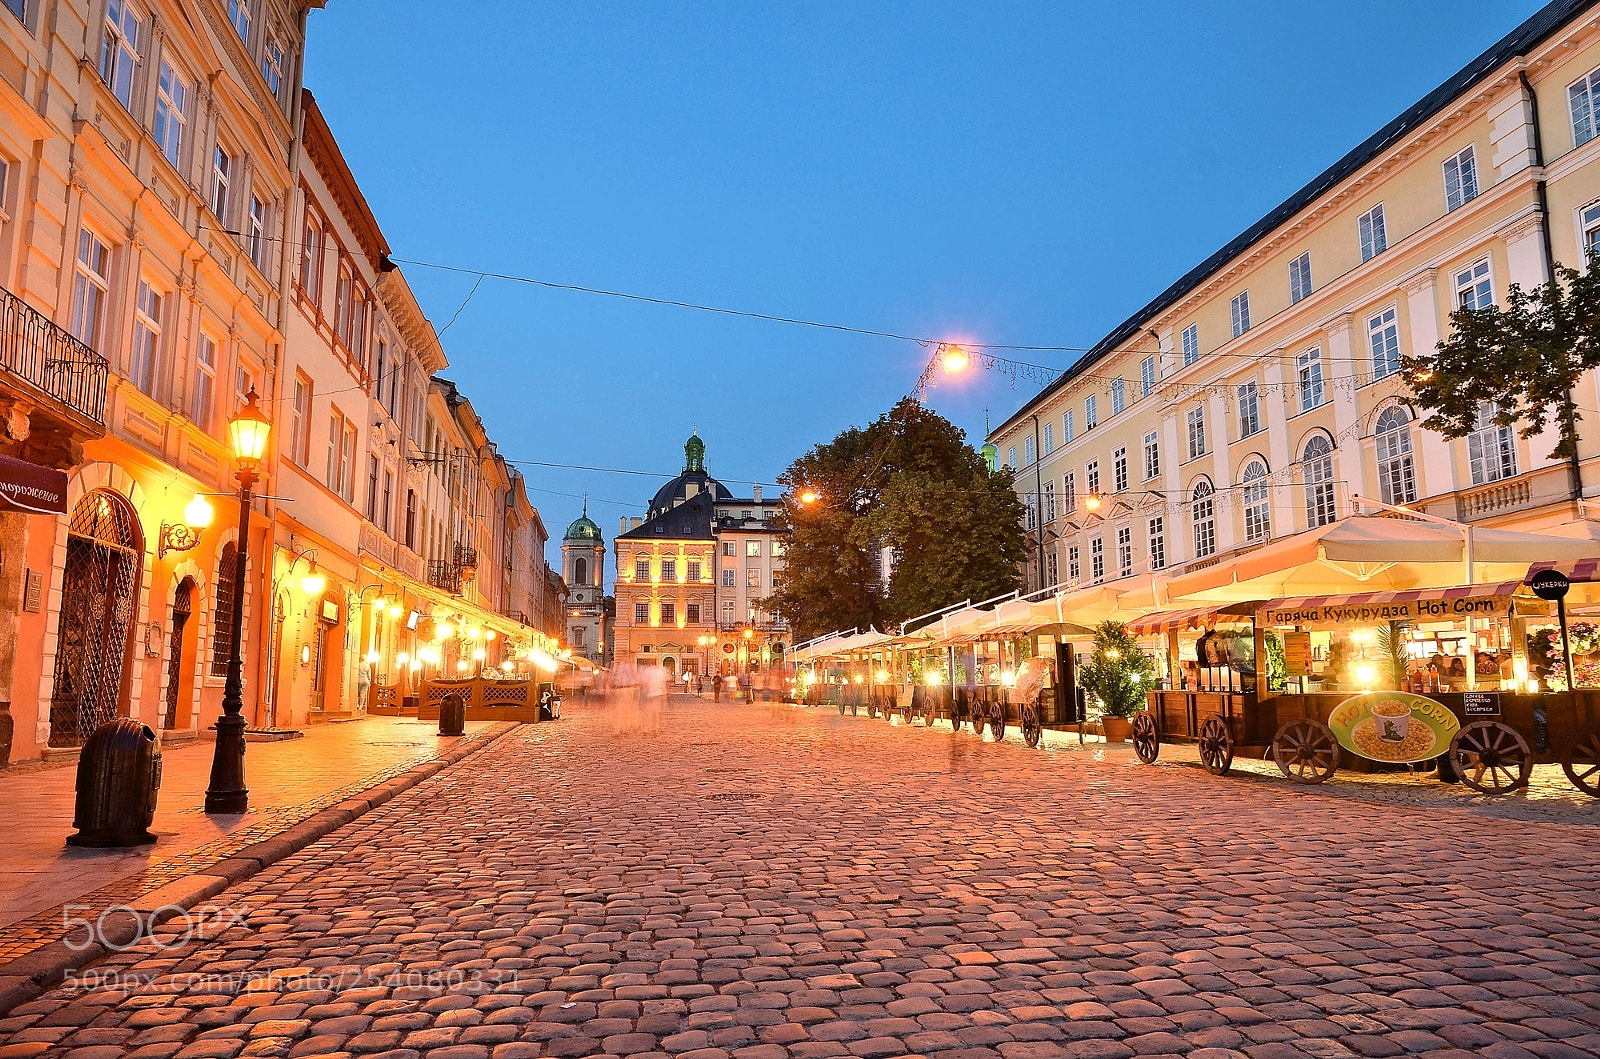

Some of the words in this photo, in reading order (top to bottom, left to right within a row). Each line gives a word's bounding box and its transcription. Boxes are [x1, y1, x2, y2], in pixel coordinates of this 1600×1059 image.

[1532, 581, 1567, 590] ЦУКЕРКИ
[1266, 610, 1318, 624] Гаряча
[1323, 606, 1409, 622] Кукурудза
[1417, 600, 1448, 615] Hot
[1453, 598, 1494, 613] Corn
[1335, 700, 1369, 728] HOT
[1409, 698, 1457, 732] CORN
